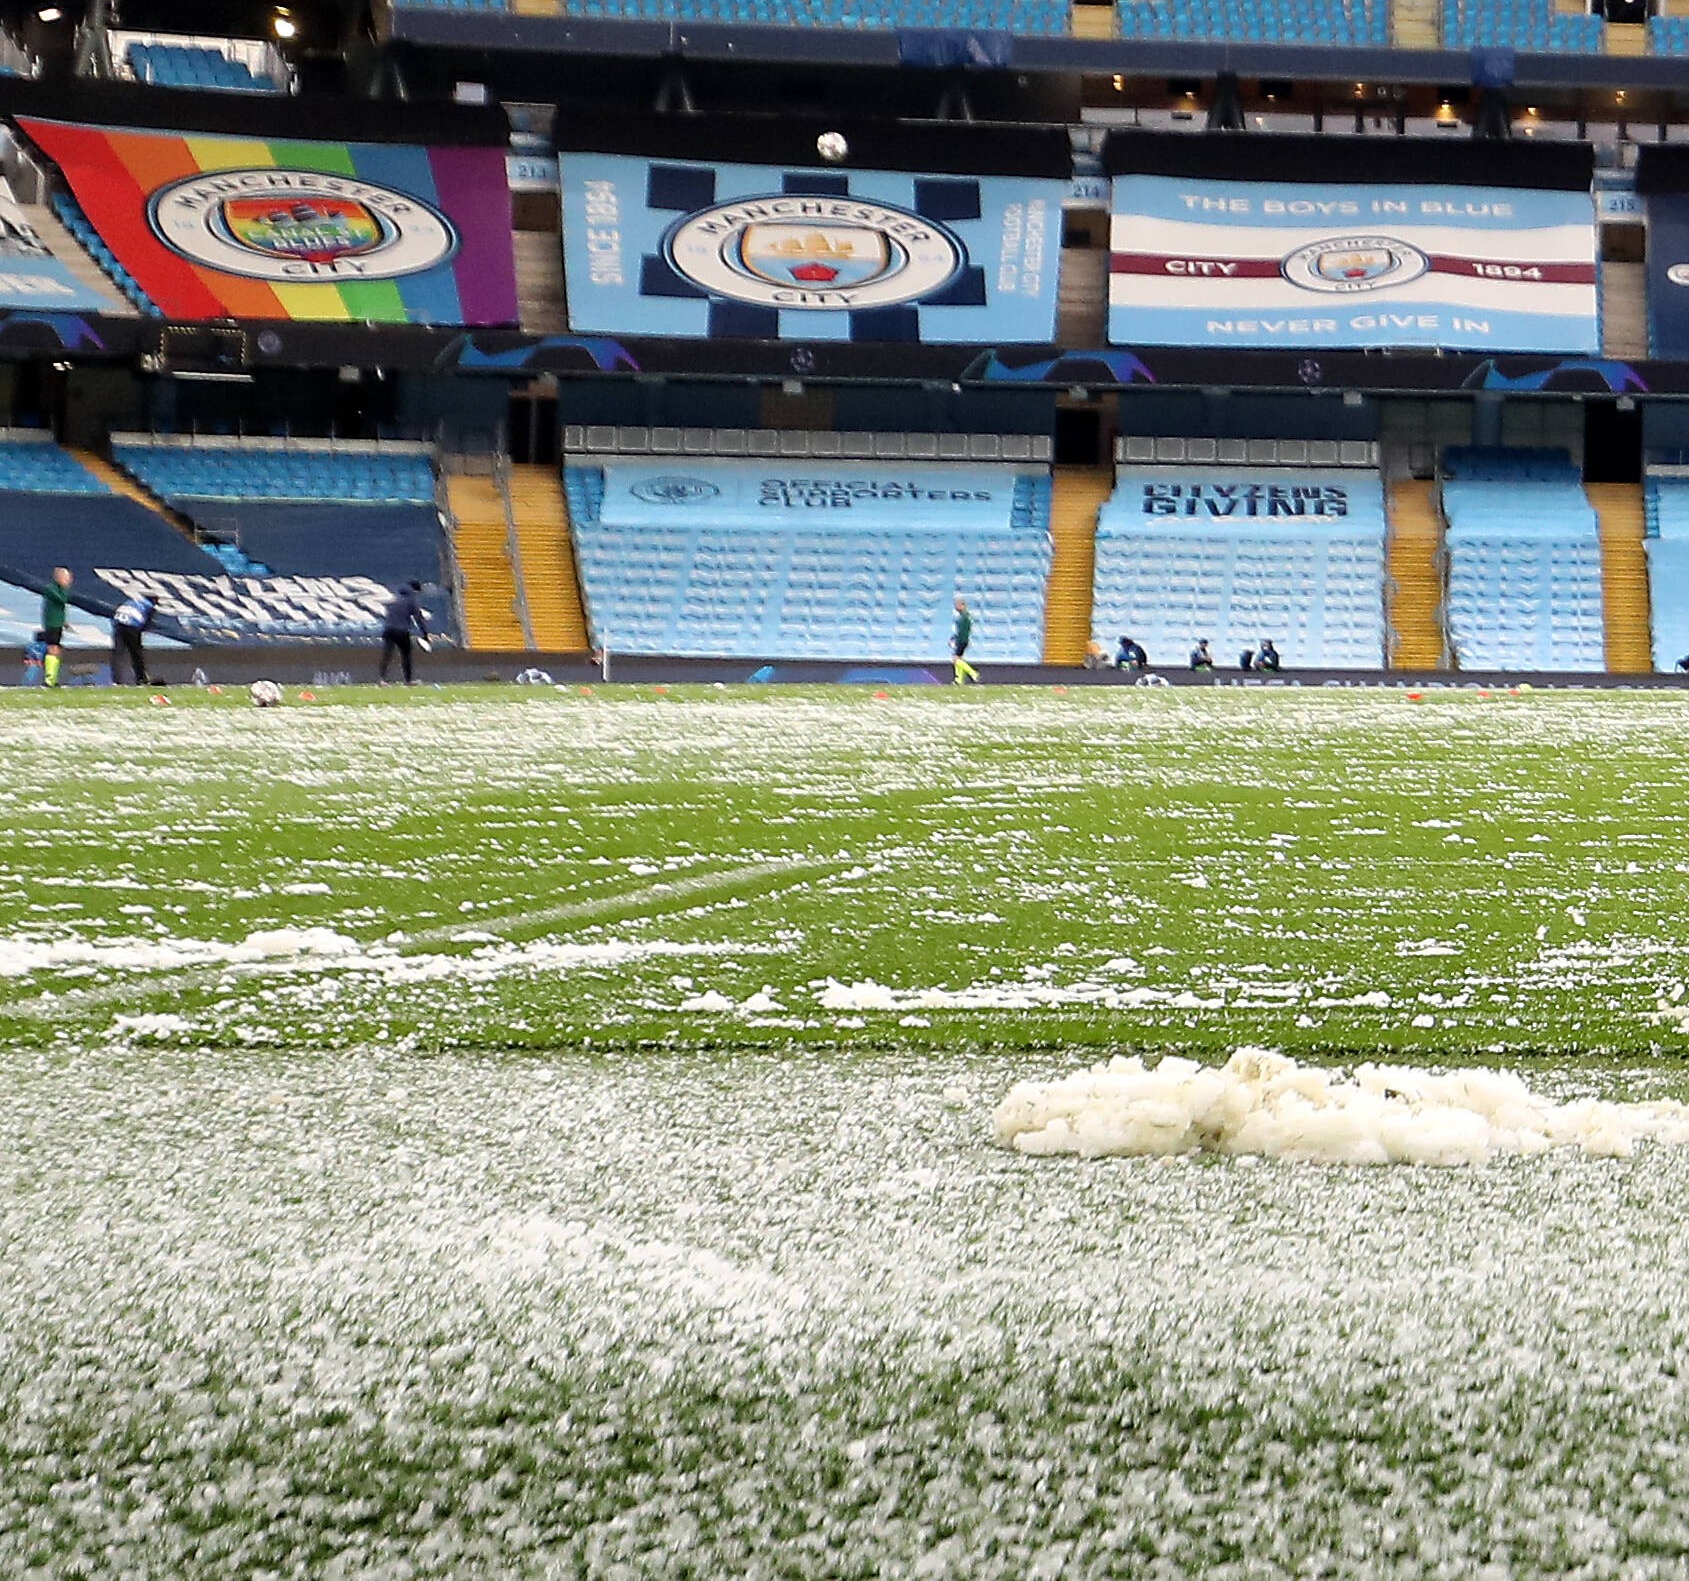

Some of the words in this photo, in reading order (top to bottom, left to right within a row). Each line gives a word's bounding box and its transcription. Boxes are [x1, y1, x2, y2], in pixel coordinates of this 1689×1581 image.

[174, 174, 411, 214] MANCHESTER
[1180, 194, 1250, 213] THE
[1263, 200, 1360, 215] BOYS
[1373, 199, 1408, 213] IN
[1420, 200, 1514, 217] BLUE
[1609, 200, 1636, 211] 215
[697, 201, 930, 242] MANCHESTER
[587, 230, 624, 284] SINCE
[281, 261, 368, 276] CITY
[1164, 259, 1239, 276] CITY
[1471, 262, 1543, 281] 1894
[771, 291, 858, 304] CITY
[1206, 319, 1337, 335] NEVER
[1350, 316, 1440, 332] GIVE
[1453, 318, 1491, 334] IN
[1142, 497, 1348, 516] GIVING
